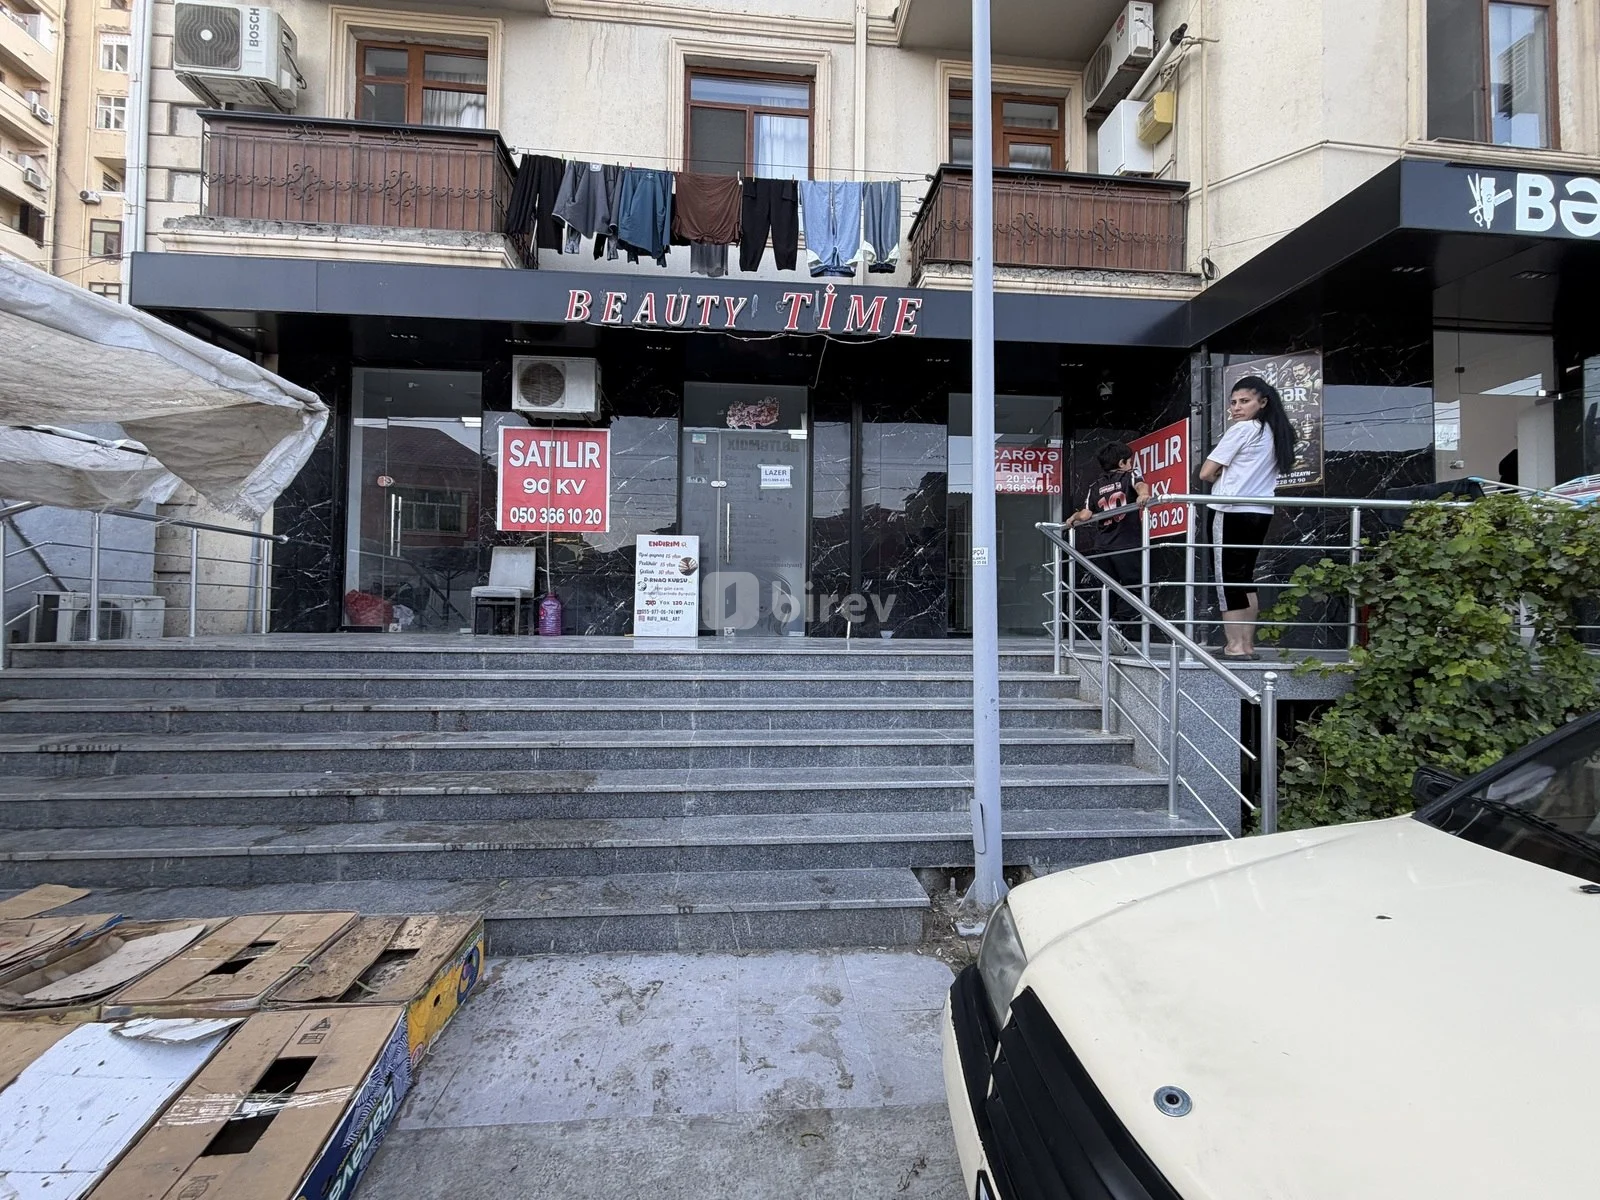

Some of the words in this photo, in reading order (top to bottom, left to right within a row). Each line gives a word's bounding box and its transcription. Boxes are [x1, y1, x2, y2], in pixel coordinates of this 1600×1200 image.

[249, 8, 260, 47] BOSCH
[565, 289, 747, 328] BEAUTY
[781, 283, 923, 335] TİME
[509, 439, 601, 468] SATILIR
[1132, 435, 1182, 475] ATILIR
[523, 478, 550, 494] 90
[556, 479, 586, 495] KV
[995, 483, 1044, 493] 0-366-10
[1006, 475, 1020, 483] 20
[509, 507, 537, 524] 050
[539, 507, 565, 525] 366
[567, 508, 582, 524] 10
[584, 508, 602, 525] 20
[1097, 491, 1127, 526] 10
[1159, 510, 1169, 527] 10
[1171, 506, 1184, 525] 20
